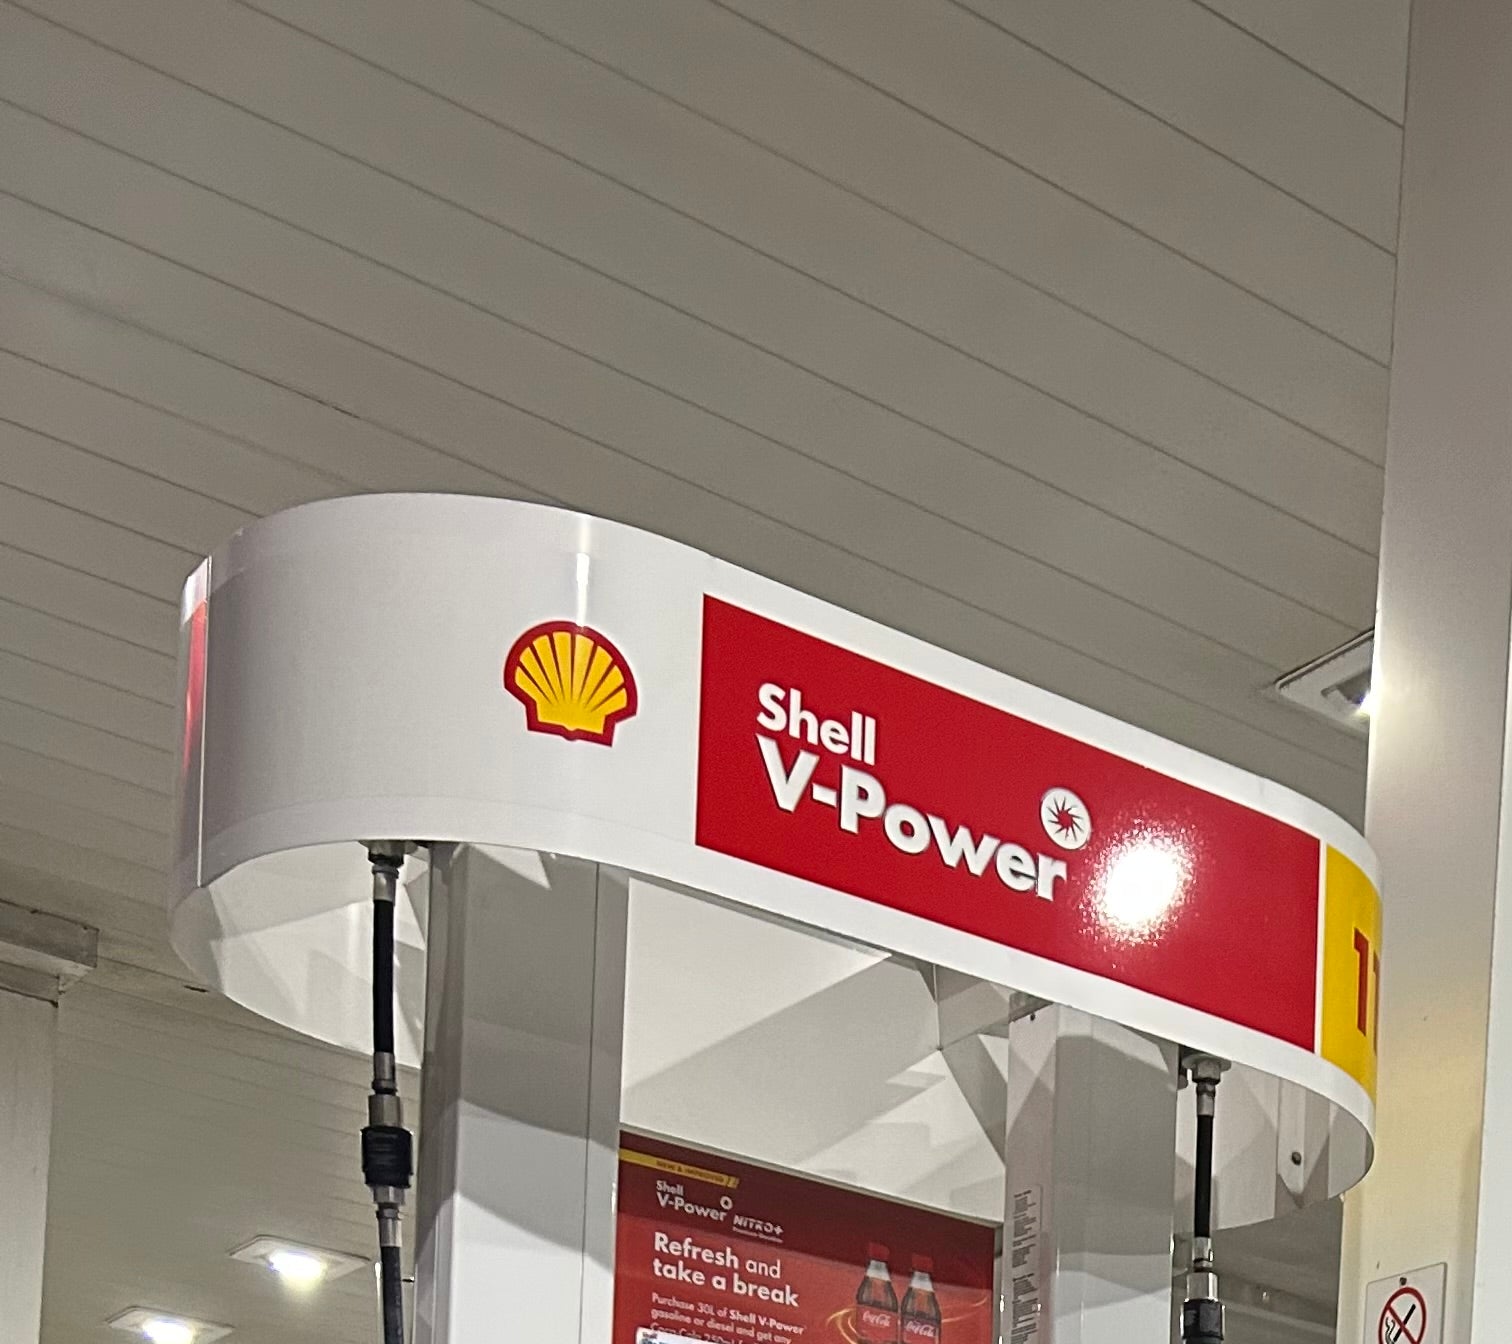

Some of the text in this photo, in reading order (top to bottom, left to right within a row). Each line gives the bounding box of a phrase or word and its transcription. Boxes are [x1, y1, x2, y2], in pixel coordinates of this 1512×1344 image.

[756, 682, 877, 766] Shell
[755, 733, 1067, 902] V-Power
[655, 1191, 728, 1222] V-Power
[656, 1180, 684, 1196] Shell
[654, 1231, 739, 1269] Refresh
[745, 1259, 781, 1279] and
[652, 1258, 800, 1307] take a break
[650, 1308, 691, 1324] gasoline
[694, 1317, 705, 1326] or
[706, 1318, 734, 1333] diesel
[736, 1324, 755, 1338] and
[756, 1329, 773, 1344] get
[652, 1292, 695, 1312] Purchase
[717, 1307, 728, 1317] of
[729, 1310, 756, 1325] Shell
[757, 1315, 804, 1335] V-Power
